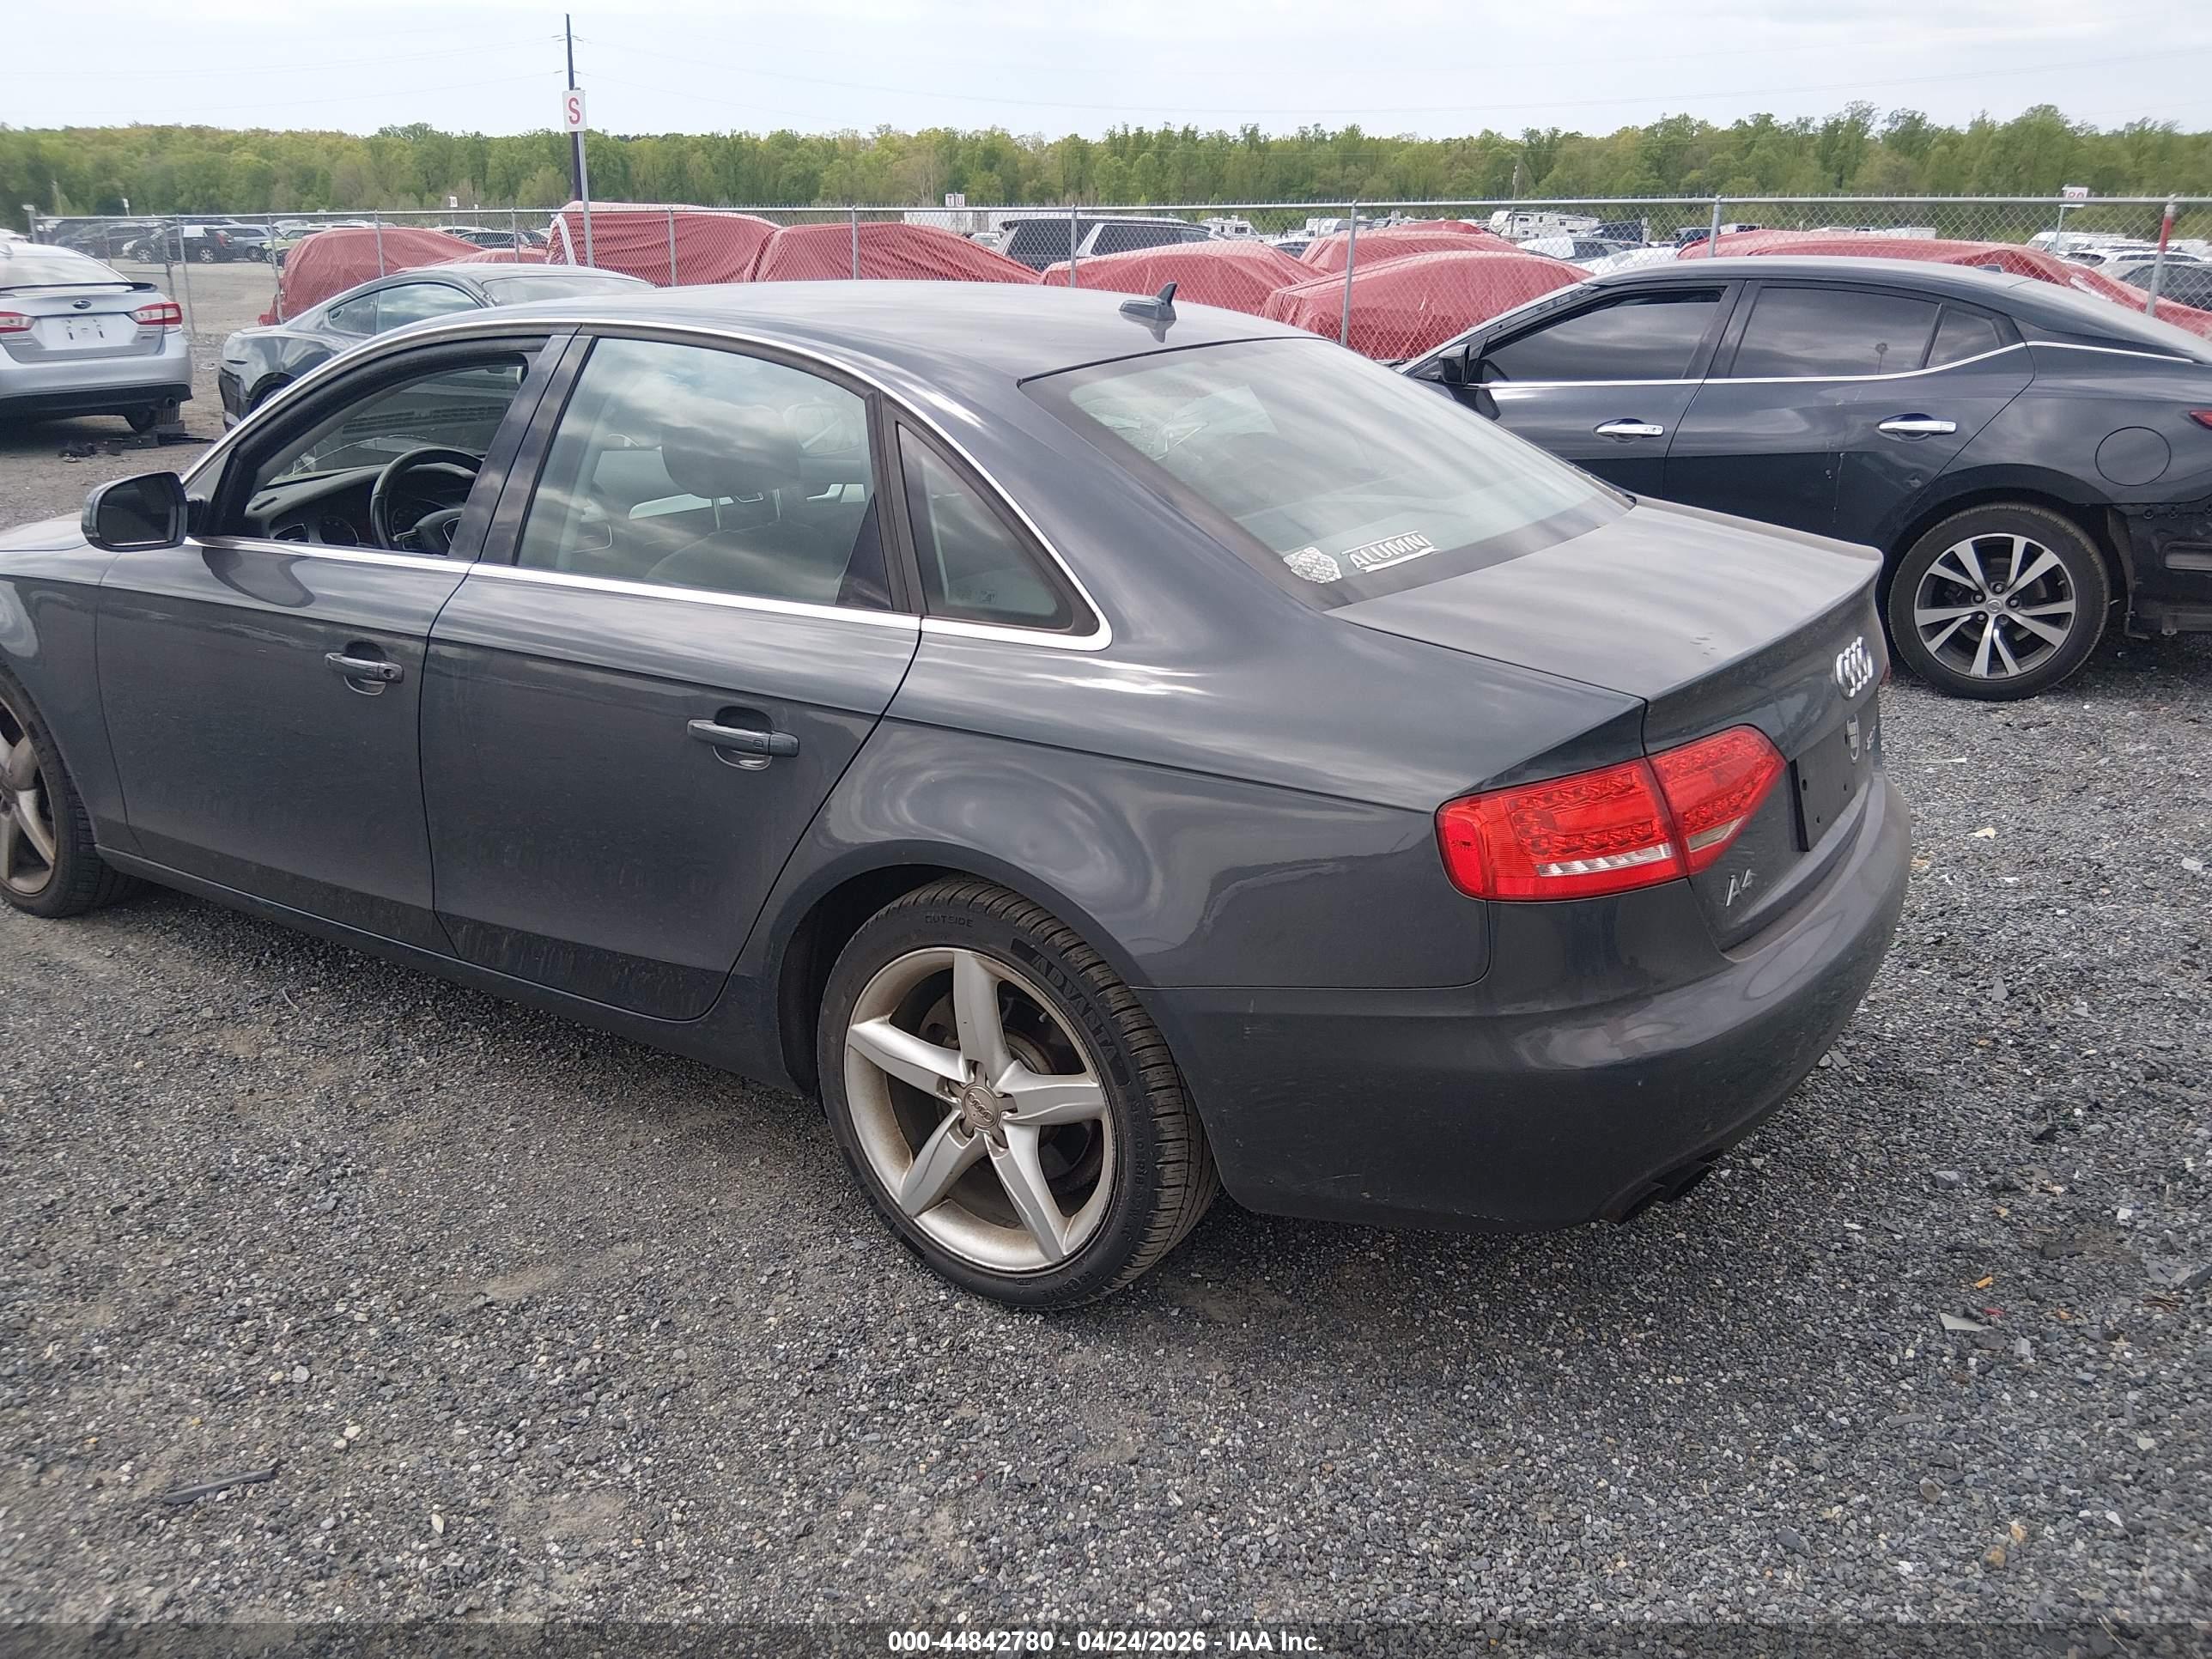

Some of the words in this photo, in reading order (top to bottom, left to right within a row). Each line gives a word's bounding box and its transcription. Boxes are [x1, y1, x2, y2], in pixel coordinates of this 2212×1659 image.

[568, 97, 581, 125] S
[1348, 533, 1433, 568] ALUMNI
[1725, 868, 1758, 908] A4
[924, 915, 974, 927] OUTSIDE
[1031, 954, 1121, 1063] ADVANTA
